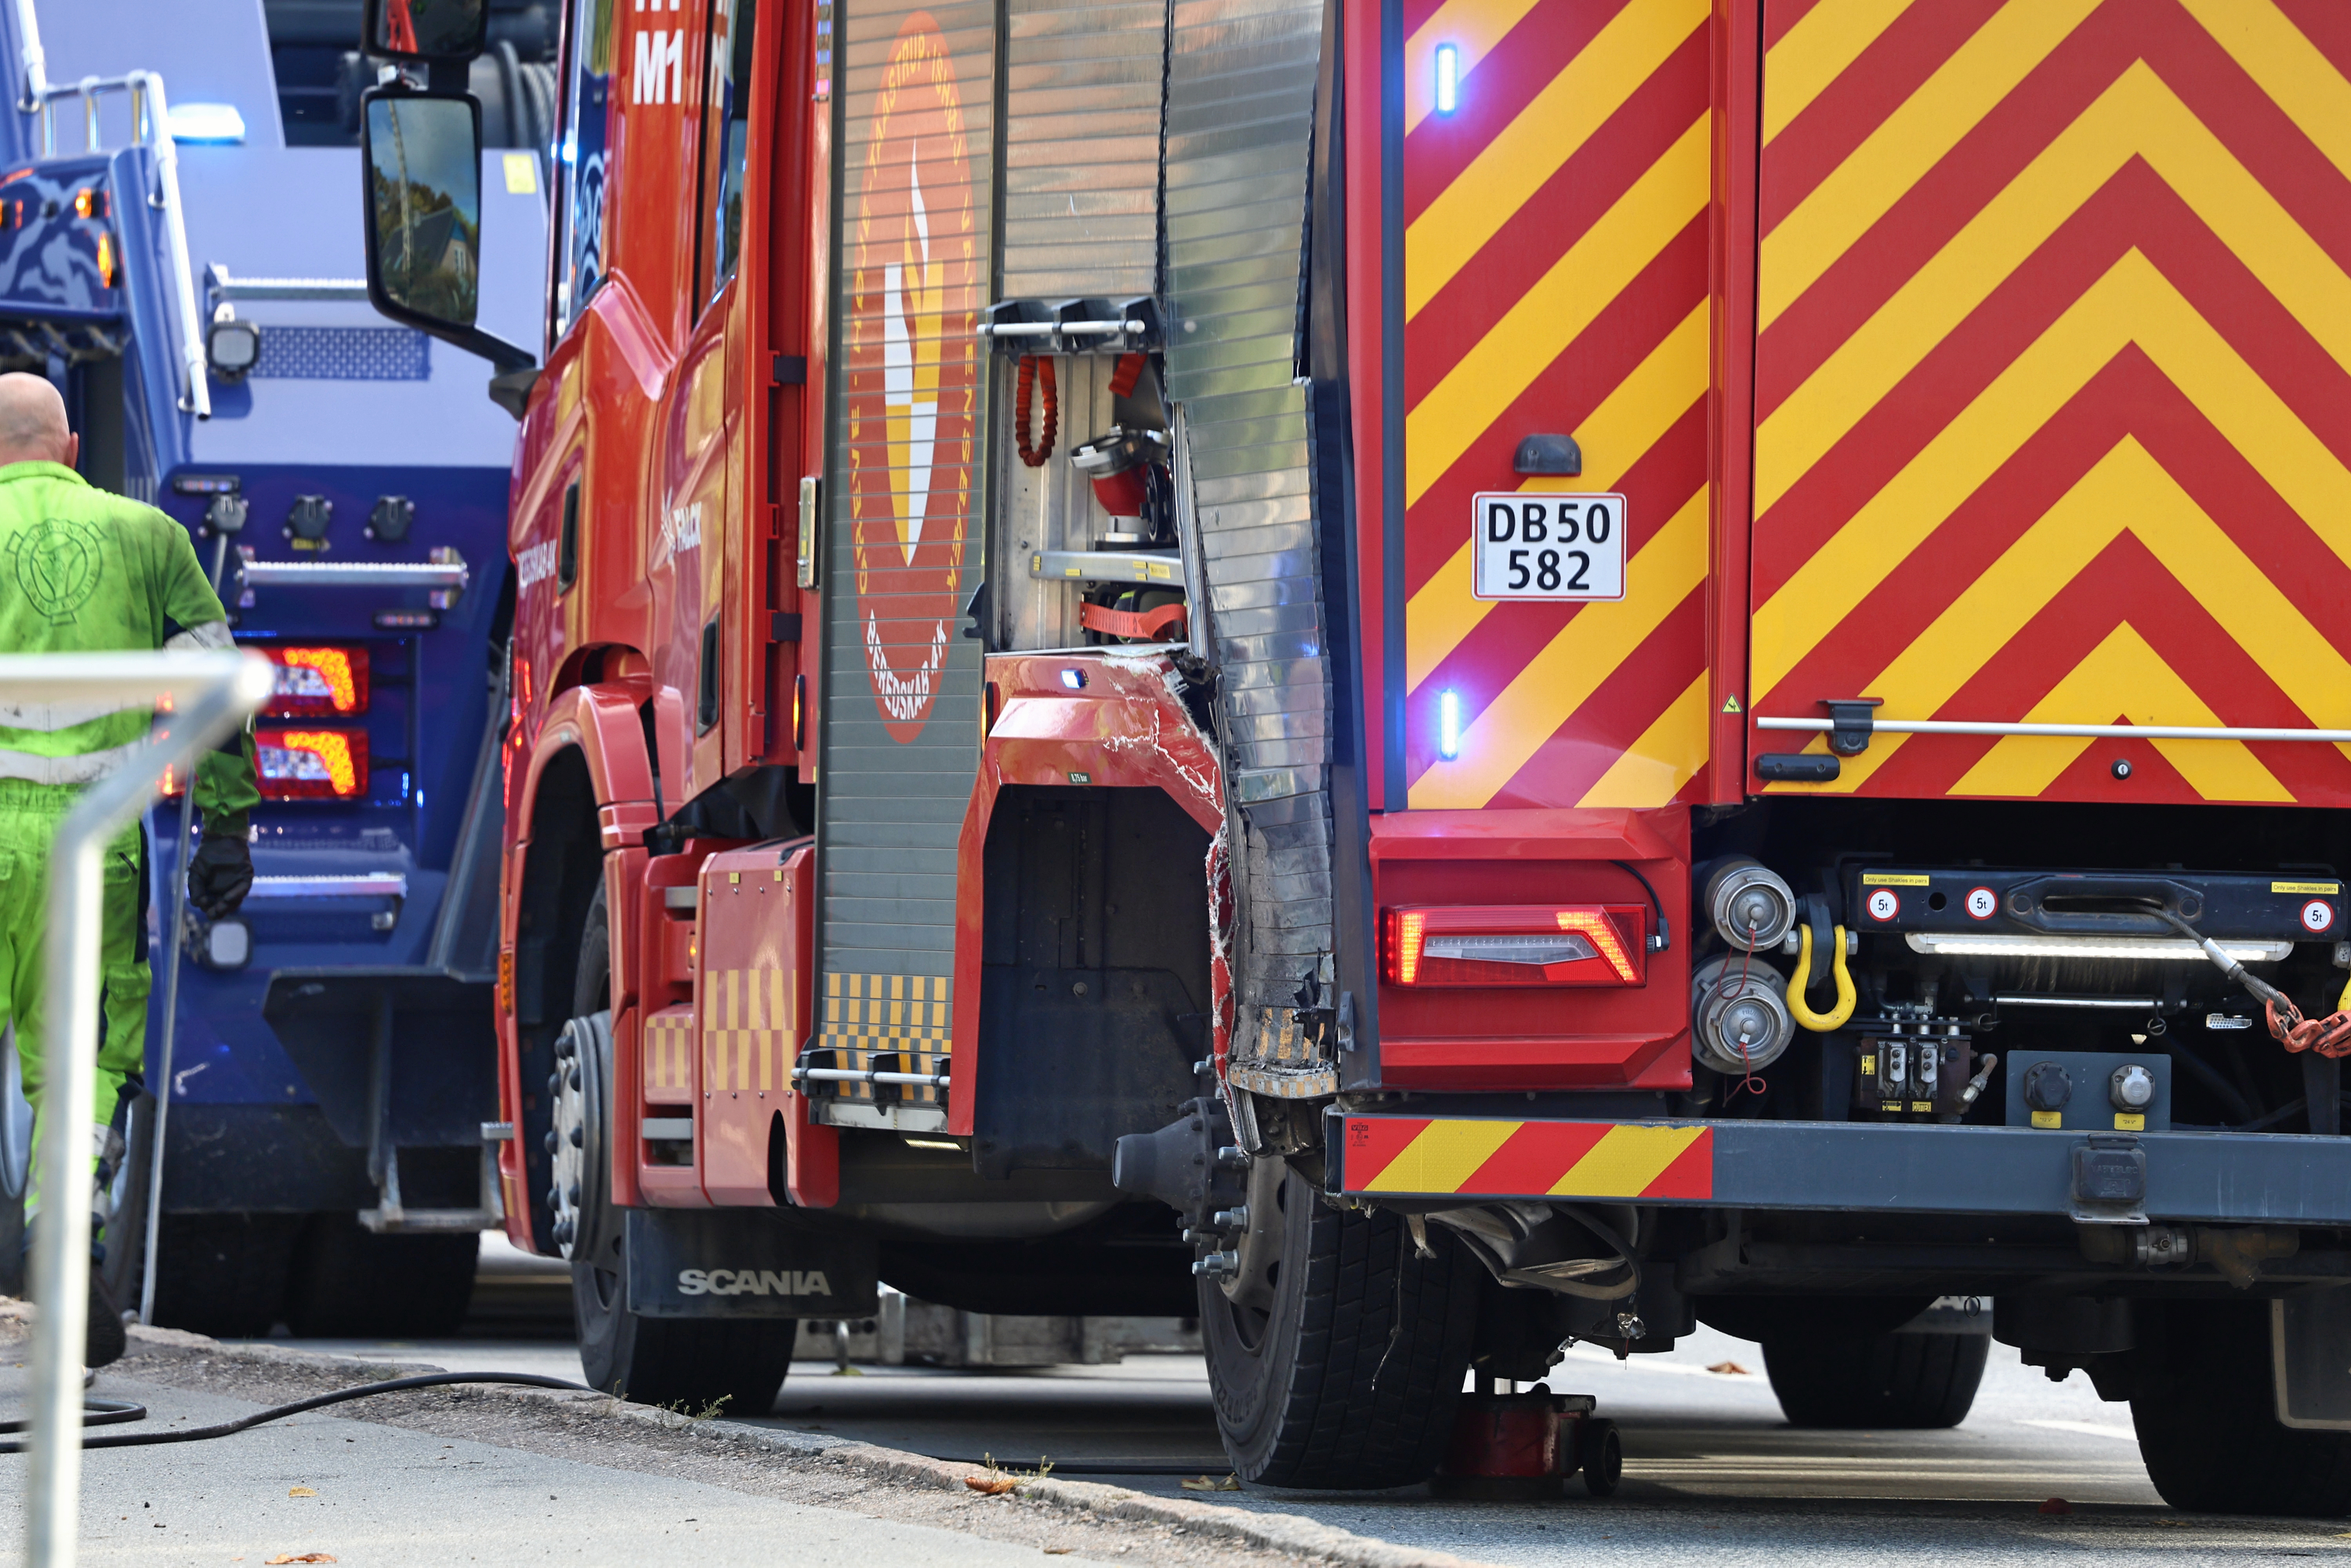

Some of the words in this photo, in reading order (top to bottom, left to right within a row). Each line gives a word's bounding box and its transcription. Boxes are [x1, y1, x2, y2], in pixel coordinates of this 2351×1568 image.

[633, 28, 684, 104] M1
[851, 404, 868, 595] GREVE
[946, 192, 974, 607] VALLENSBÆK
[1509, 549, 1590, 590] 582
[867, 608, 929, 720] BEREDSKAB
[1878, 899, 1889, 911] 5t
[1976, 897, 1987, 909] 5t
[2312, 910, 2323, 922] 5t
[677, 1269, 832, 1296] SCANIA
